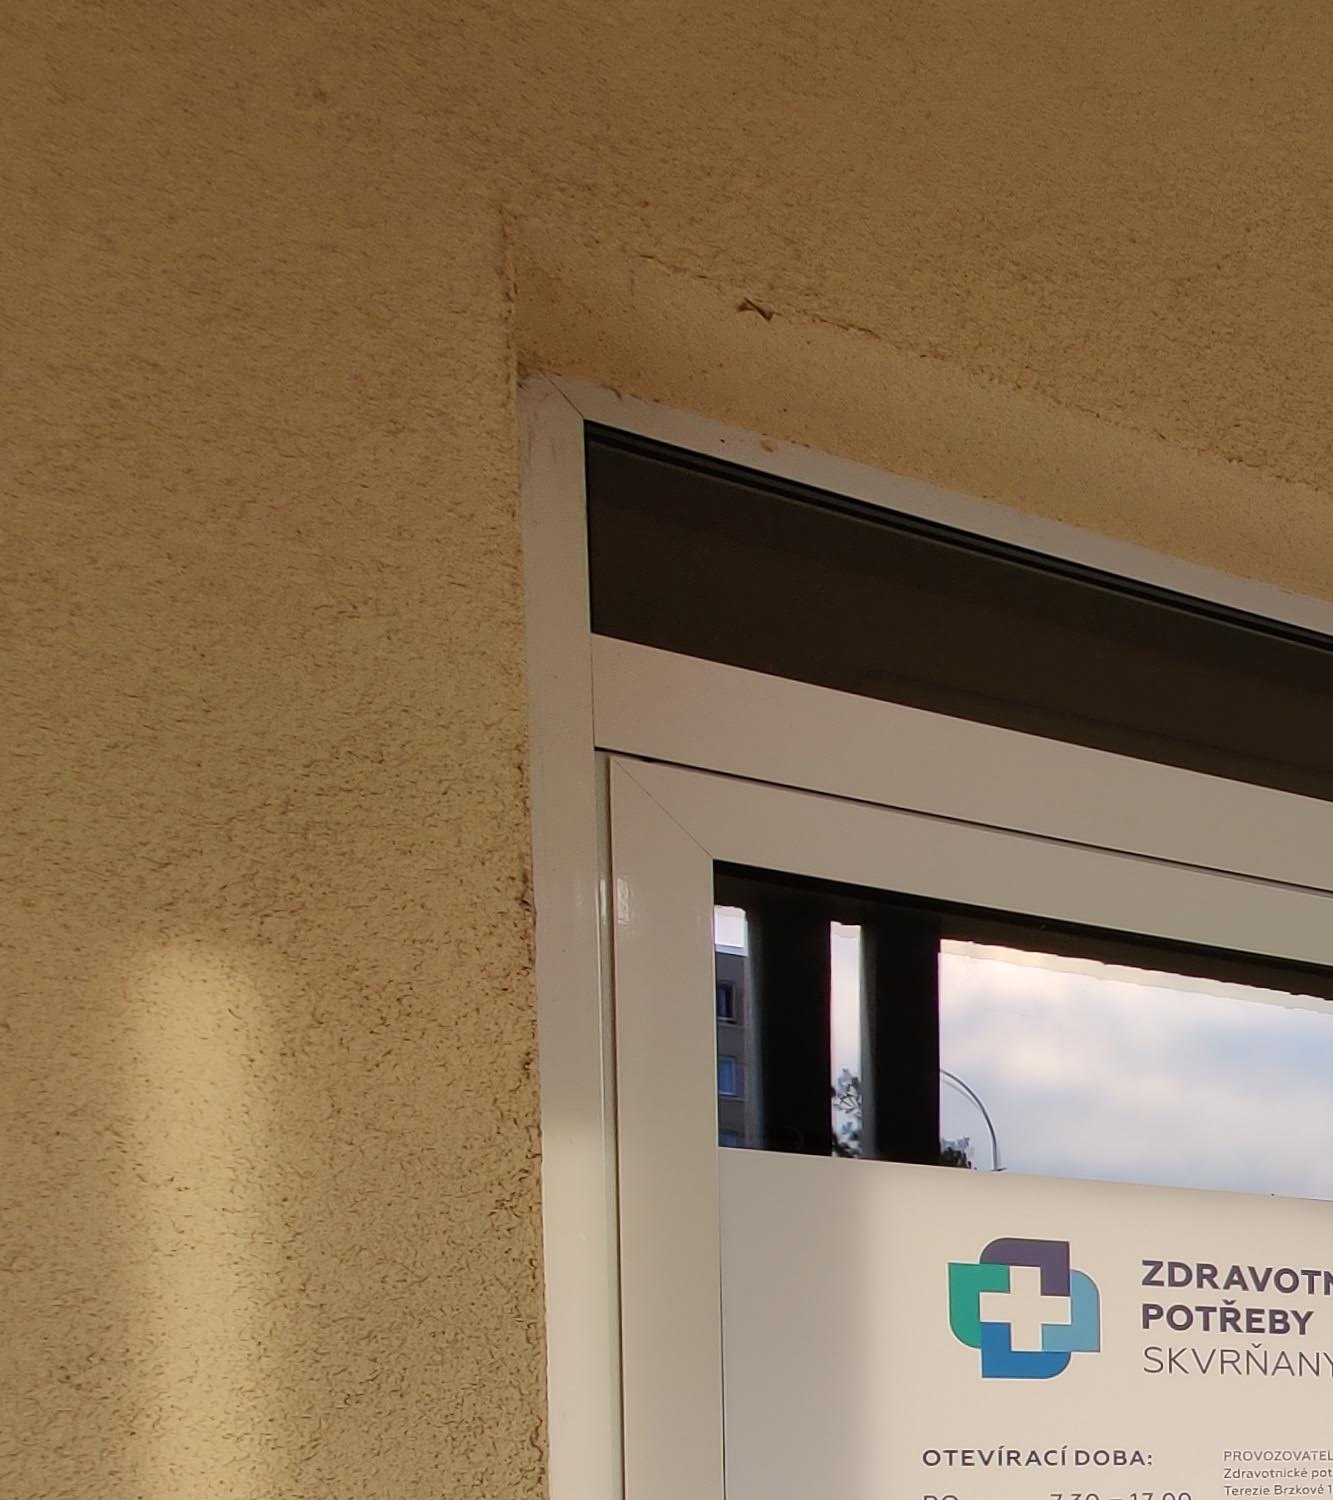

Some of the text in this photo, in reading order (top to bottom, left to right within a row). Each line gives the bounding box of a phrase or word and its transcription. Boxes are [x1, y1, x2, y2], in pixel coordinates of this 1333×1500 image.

[1142, 1300, 1314, 1335] POTŘEBY
[923, 1446, 1153, 1466] OTEVÍRACÍ DOBA:
[1223, 1467, 1308, 1479] Zdravotnické
[1223, 1485, 1271, 1497] Terezie
[1273, 1483, 1325, 1496] Brzkové
